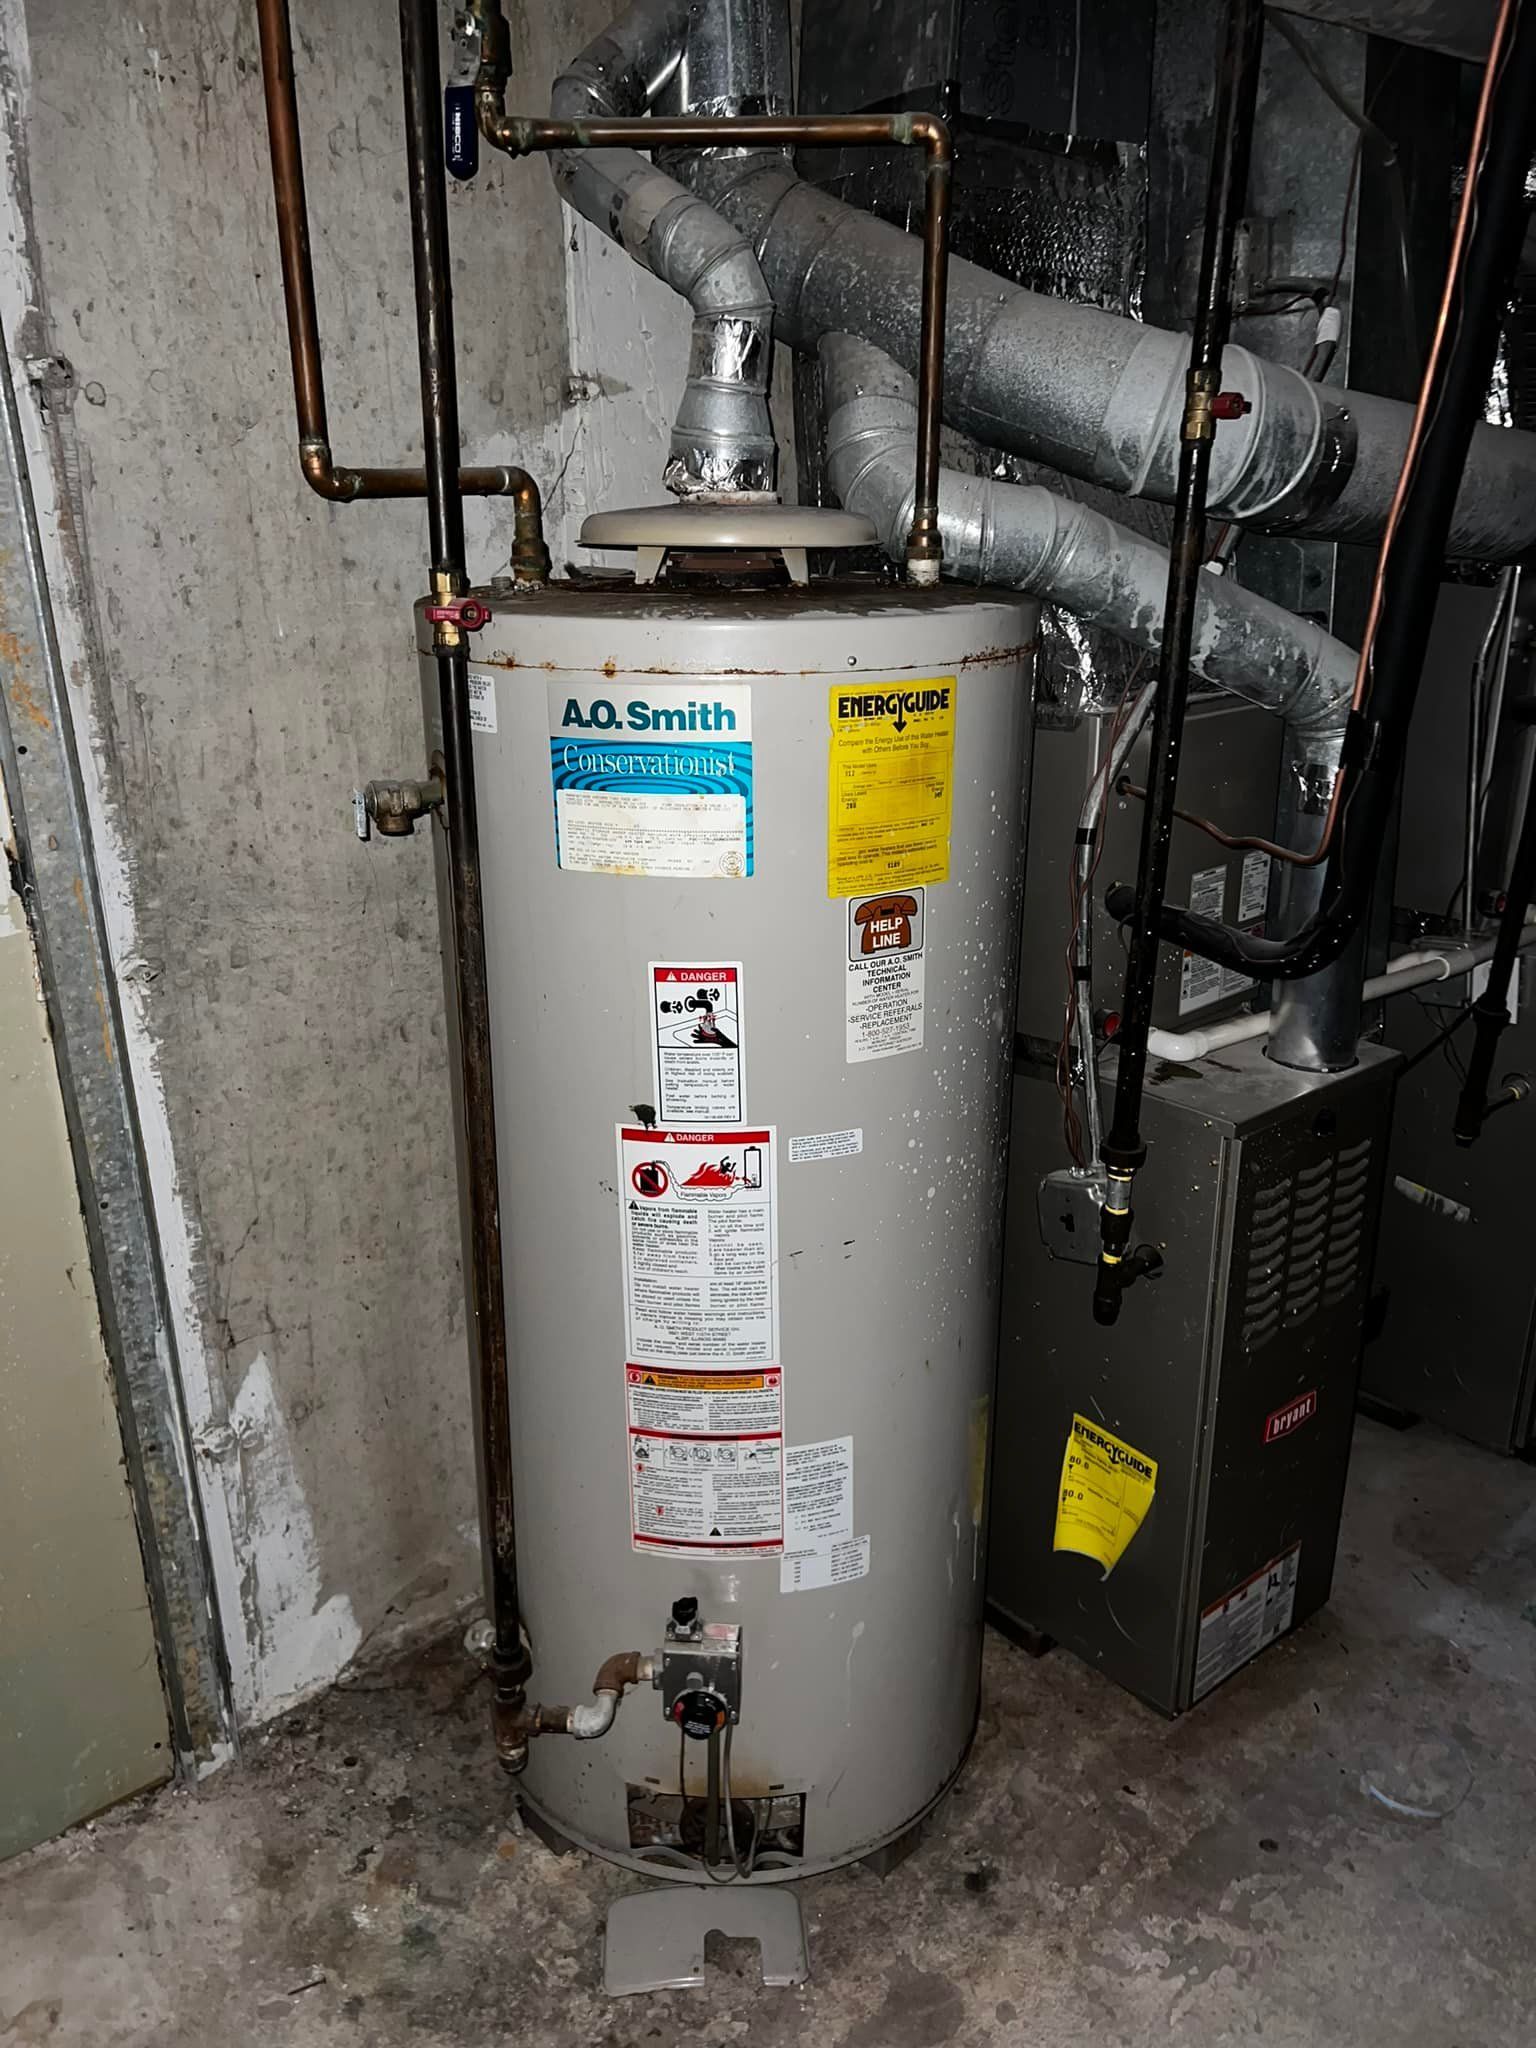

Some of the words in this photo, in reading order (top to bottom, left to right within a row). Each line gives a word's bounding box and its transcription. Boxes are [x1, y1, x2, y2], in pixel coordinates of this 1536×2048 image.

[838, 688, 950, 718] ENERGYGUIDE
[562, 698, 623, 730] A.O.
[627, 701, 737, 731] Smith
[563, 744, 736, 777] Conservationist
[870, 917, 904, 934] HELP
[872, 932, 902, 949] LINE
[848, 962, 869, 972] CALL
[870, 959, 887, 969] OUR
[887, 957, 901, 967] A.O.
[902, 952, 924, 963] SMITH
[680, 972, 727, 981] DANGER
[862, 971, 911, 987] INFORMATION
[867, 964, 907, 978] TECHNICAL
[872, 981, 902, 994] CENTER
[676, 1134, 715, 1142] DANGER
[1273, 1398, 1311, 1435] bryant
[1074, 1421, 1153, 1479] ENERGYGUIDE
[1069, 1455, 1090, 1470] 80.0
